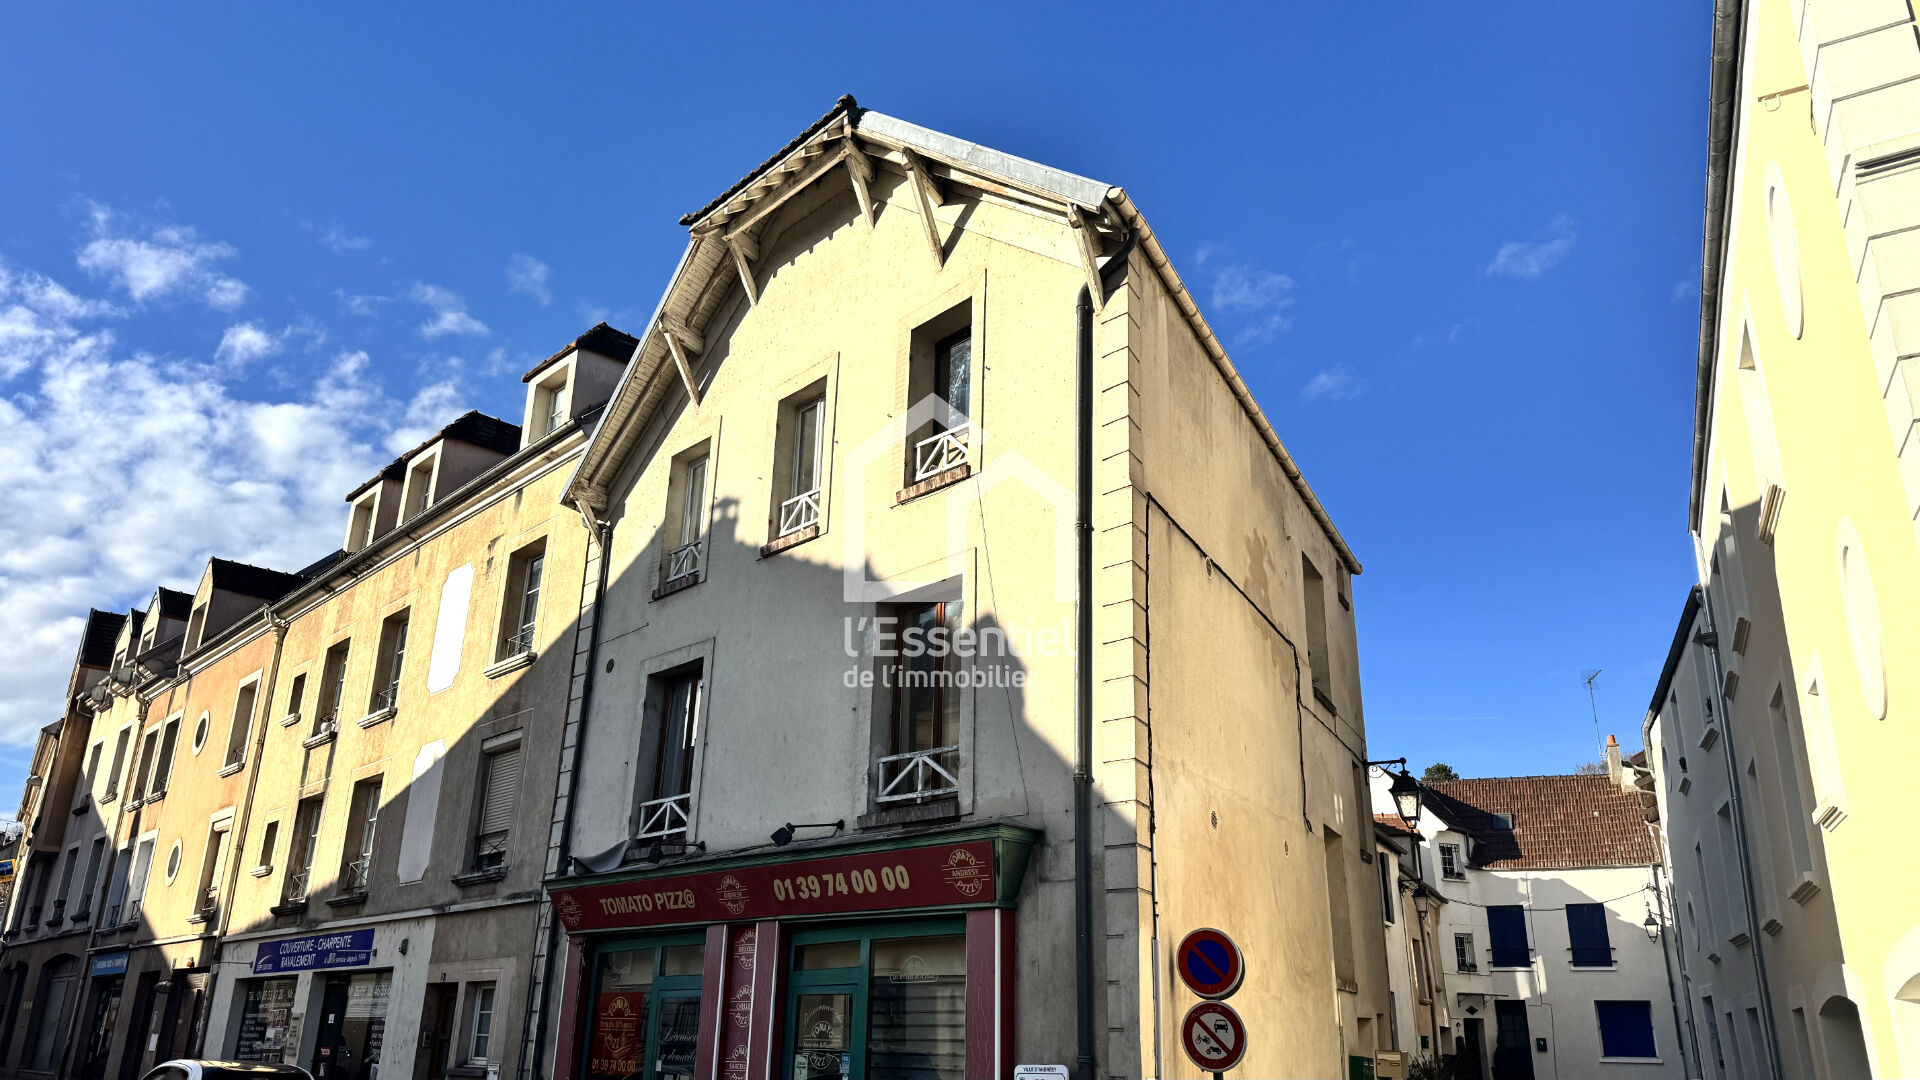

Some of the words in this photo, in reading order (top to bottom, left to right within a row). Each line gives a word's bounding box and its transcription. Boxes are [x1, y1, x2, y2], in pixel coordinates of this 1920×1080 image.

[950, 851, 976, 867] TOMATO
[773, 878, 796, 901] 01
[796, 875, 820, 900] 39
[822, 873, 849, 897] 74
[851, 868, 878, 894] 00
[881, 865, 911, 891] 00
[600, 894, 653, 916] TOMATO
[654, 889, 696, 911] PIZZ@
[280, 939, 315, 955] COUVERTURE
[317, 935, 352, 951] CHARPENTE
[280, 954, 317, 968] RAVALEMENT
[608, 999, 630, 1017] TOMATO
[812, 1023, 834, 1038] TOMATO
[600, 1060, 609, 1070] 39
[610, 1060, 617, 1071] 74
[618, 1060, 627, 1072] 00
[627, 1060, 636, 1072] 00
